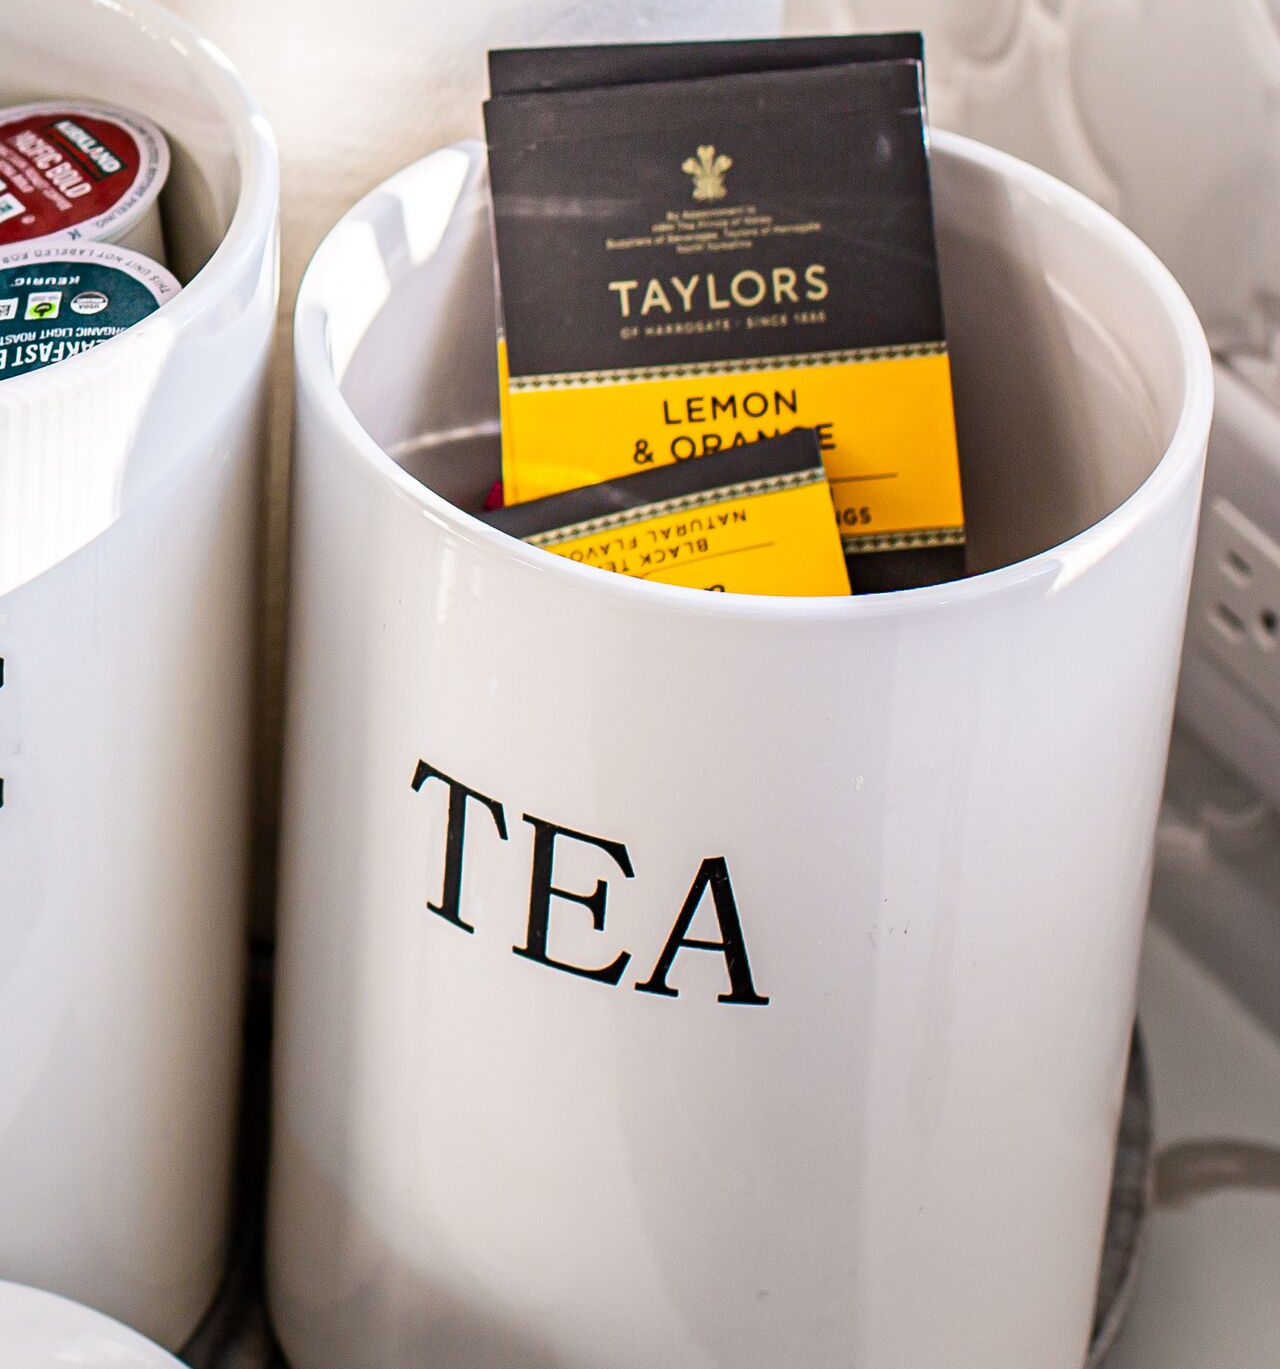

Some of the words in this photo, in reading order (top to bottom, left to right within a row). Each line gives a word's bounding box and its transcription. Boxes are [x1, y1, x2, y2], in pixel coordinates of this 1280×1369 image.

[53, 119, 122, 173] KIRKLAND
[45, 161, 92, 199] BOLD
[34, 247, 94, 258] LABELED
[14, 275, 81, 287] KEURIG
[608, 263, 829, 318] TAYLORS
[0, 331, 35, 347] ROAST
[39, 327, 72, 343] LIGHT
[11, 338, 106, 368] AKFAST
[663, 389, 797, 425] LEMON
[633, 438, 655, 465] &
[650, 508, 747, 541] NATURAL
[562, 536, 638, 564] FLAVO
[640, 537, 709, 567] BLACK
[411, 759, 770, 1005] TEA
